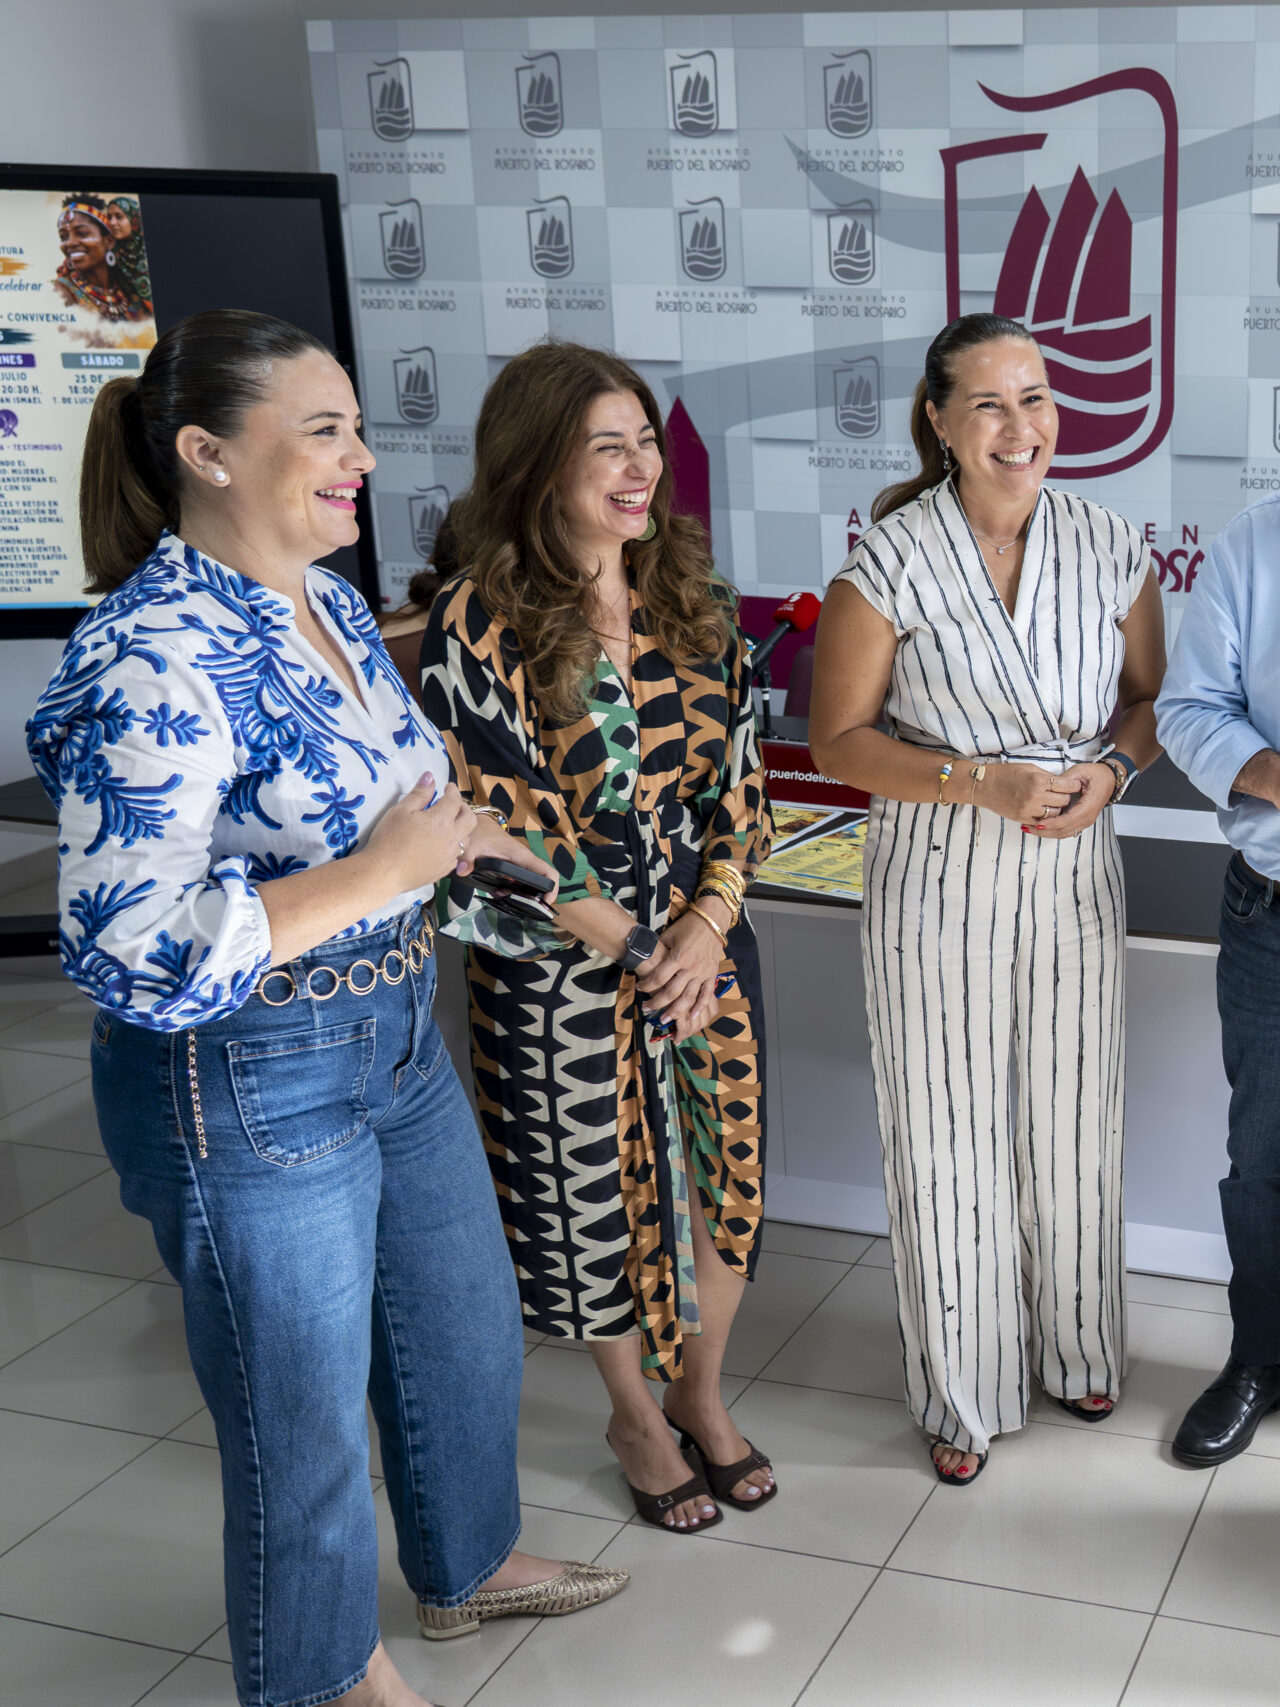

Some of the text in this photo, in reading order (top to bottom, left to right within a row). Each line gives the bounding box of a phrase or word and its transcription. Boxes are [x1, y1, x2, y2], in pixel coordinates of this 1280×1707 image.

[648, 148, 750, 156] AYUNTAMIENTO
[798, 149, 904, 158] AYUNTAMIENTO
[386, 163, 402, 174] DEL
[495, 158, 596, 172] PUERTO DEL ROSARIO
[647, 159, 751, 172] PUERTO DEL ROSARIO
[797, 160, 904, 173] PUERTO DEL ROSARIO
[656, 291, 757, 299] AYUNTAMIENTO
[802, 295, 906, 304] AYUNTAMIENTO
[400, 300, 416, 311] DEL
[506, 298, 606, 312] PUERTO DEL ROSARIO
[656, 301, 758, 314] PUERTO DEL ROSARIO
[8, 312, 76, 322] CONVIVENCIA
[801, 305, 906, 319] PUERTO DEL ROSARIO
[80, 354, 124, 366] SÁBADO
[2, 372, 27, 381] JULIO
[75, 374, 86, 383] 25
[90, 374, 104, 383] DE
[809, 446, 912, 457] AYUNTAMIENTO
[808, 456, 912, 472] PUERTO DEL ROSARIO
[1240, 478, 1280, 490] PUERTO
